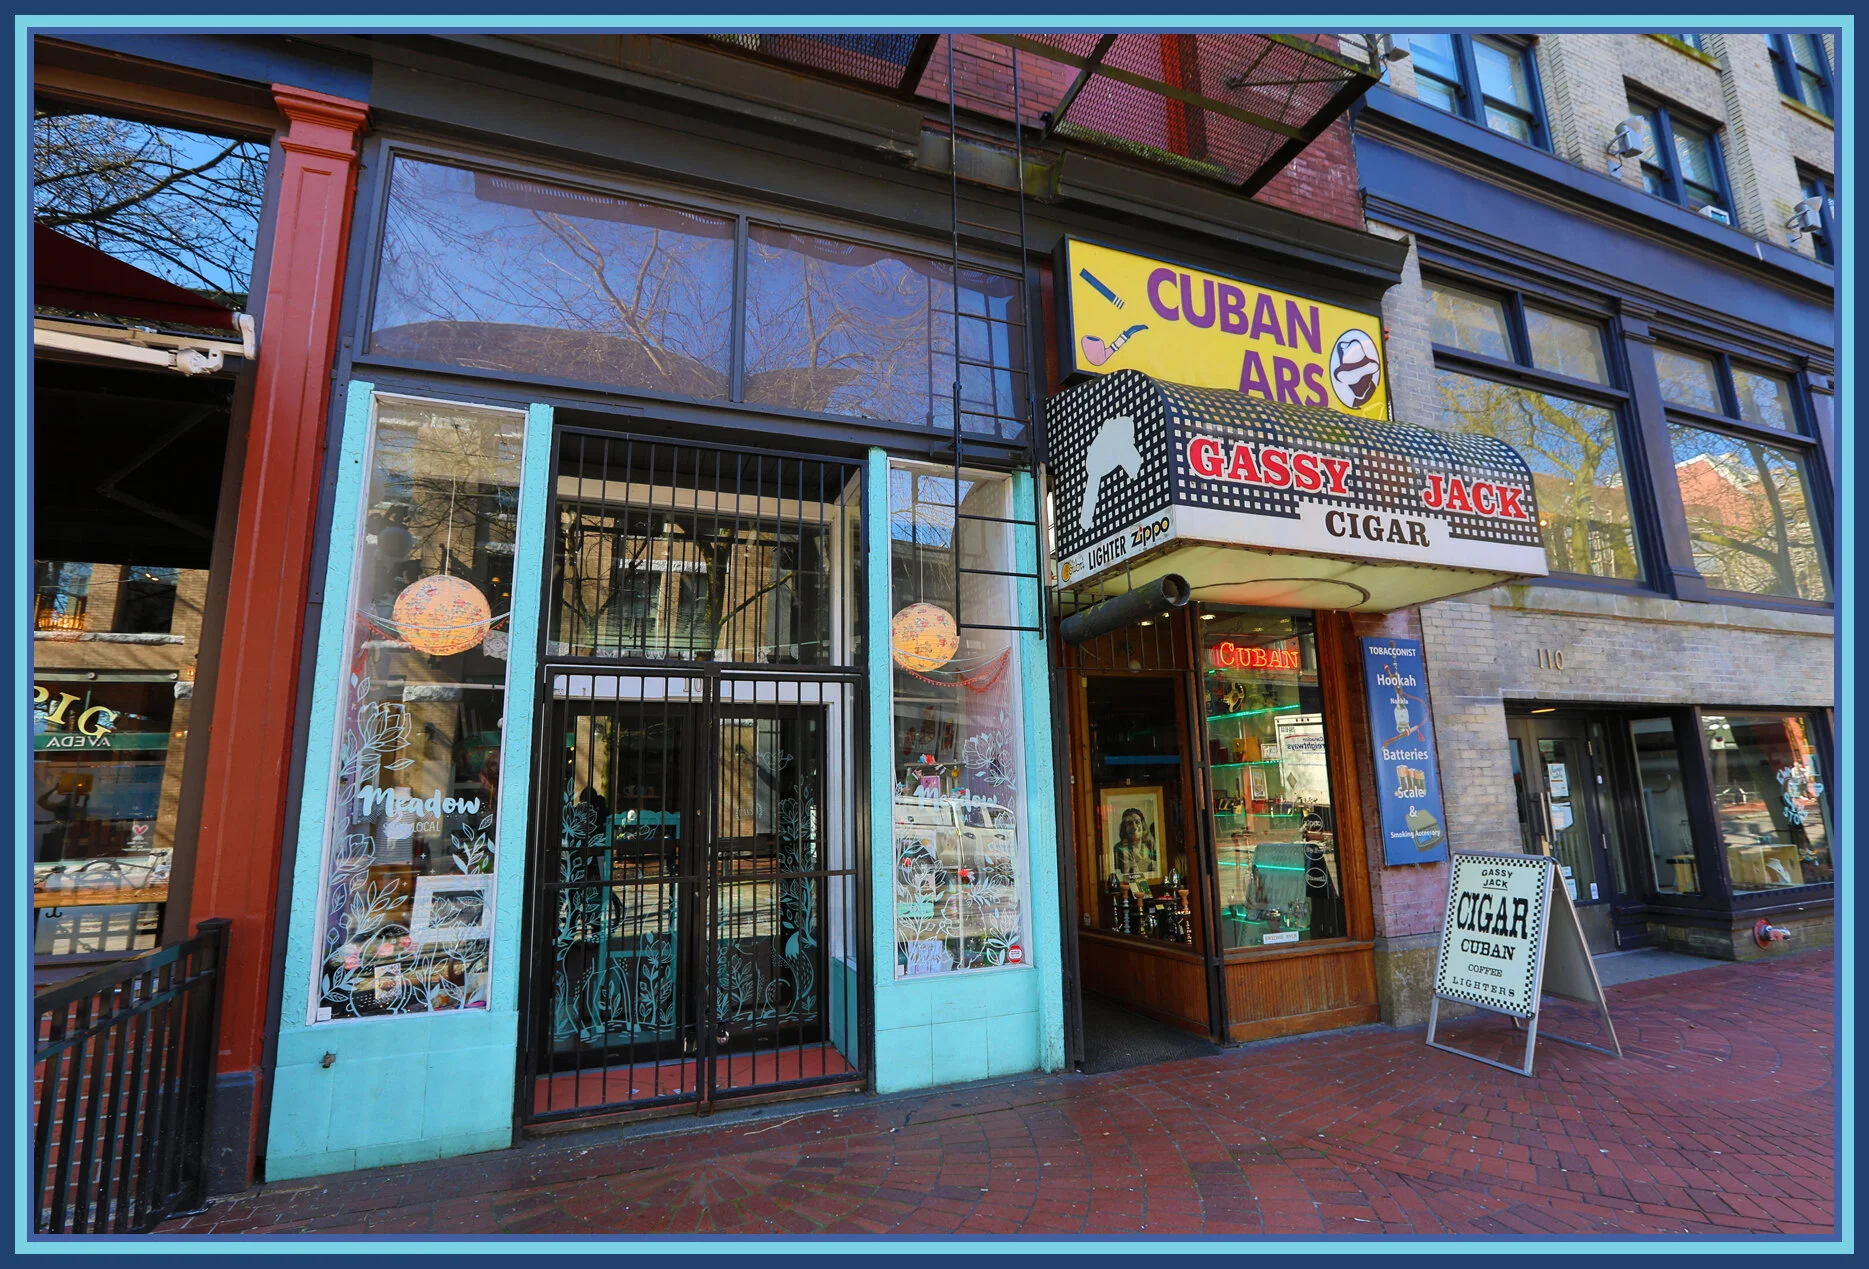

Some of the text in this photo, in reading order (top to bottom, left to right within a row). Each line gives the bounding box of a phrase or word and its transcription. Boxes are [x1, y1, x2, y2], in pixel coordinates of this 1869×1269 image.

[1147, 267, 1322, 355] CUBAN
[1239, 349, 1329, 408] ARS
[1188, 437, 1530, 521] GASSY JACK
[1325, 510, 1430, 548] CIGAR
[1088, 535, 1127, 570] LIGHTER
[1131, 516, 1170, 548] zippo
[1219, 641, 1300, 669] CUBAN
[1368, 646, 1416, 657] TOBACCONIST
[1537, 648, 1565, 671] 110
[1377, 674, 1417, 687] Hookah
[1383, 748, 1429, 762] Batteries
[357, 784, 480, 819] Meadow
[1397, 786, 1425, 799] Scale
[1409, 805, 1418, 818] &
[412, 821, 441, 833] LOCAL
[1390, 830, 1415, 838] Smoking
[1481, 868, 1514, 878] GASSY
[1483, 879, 1508, 888] JACK
[1457, 891, 1529, 940] CIGAR
[1461, 938, 1516, 961] CUBAN
[1468, 963, 1503, 978] COFFEE
[1453, 976, 1516, 998] LIGHTERS
